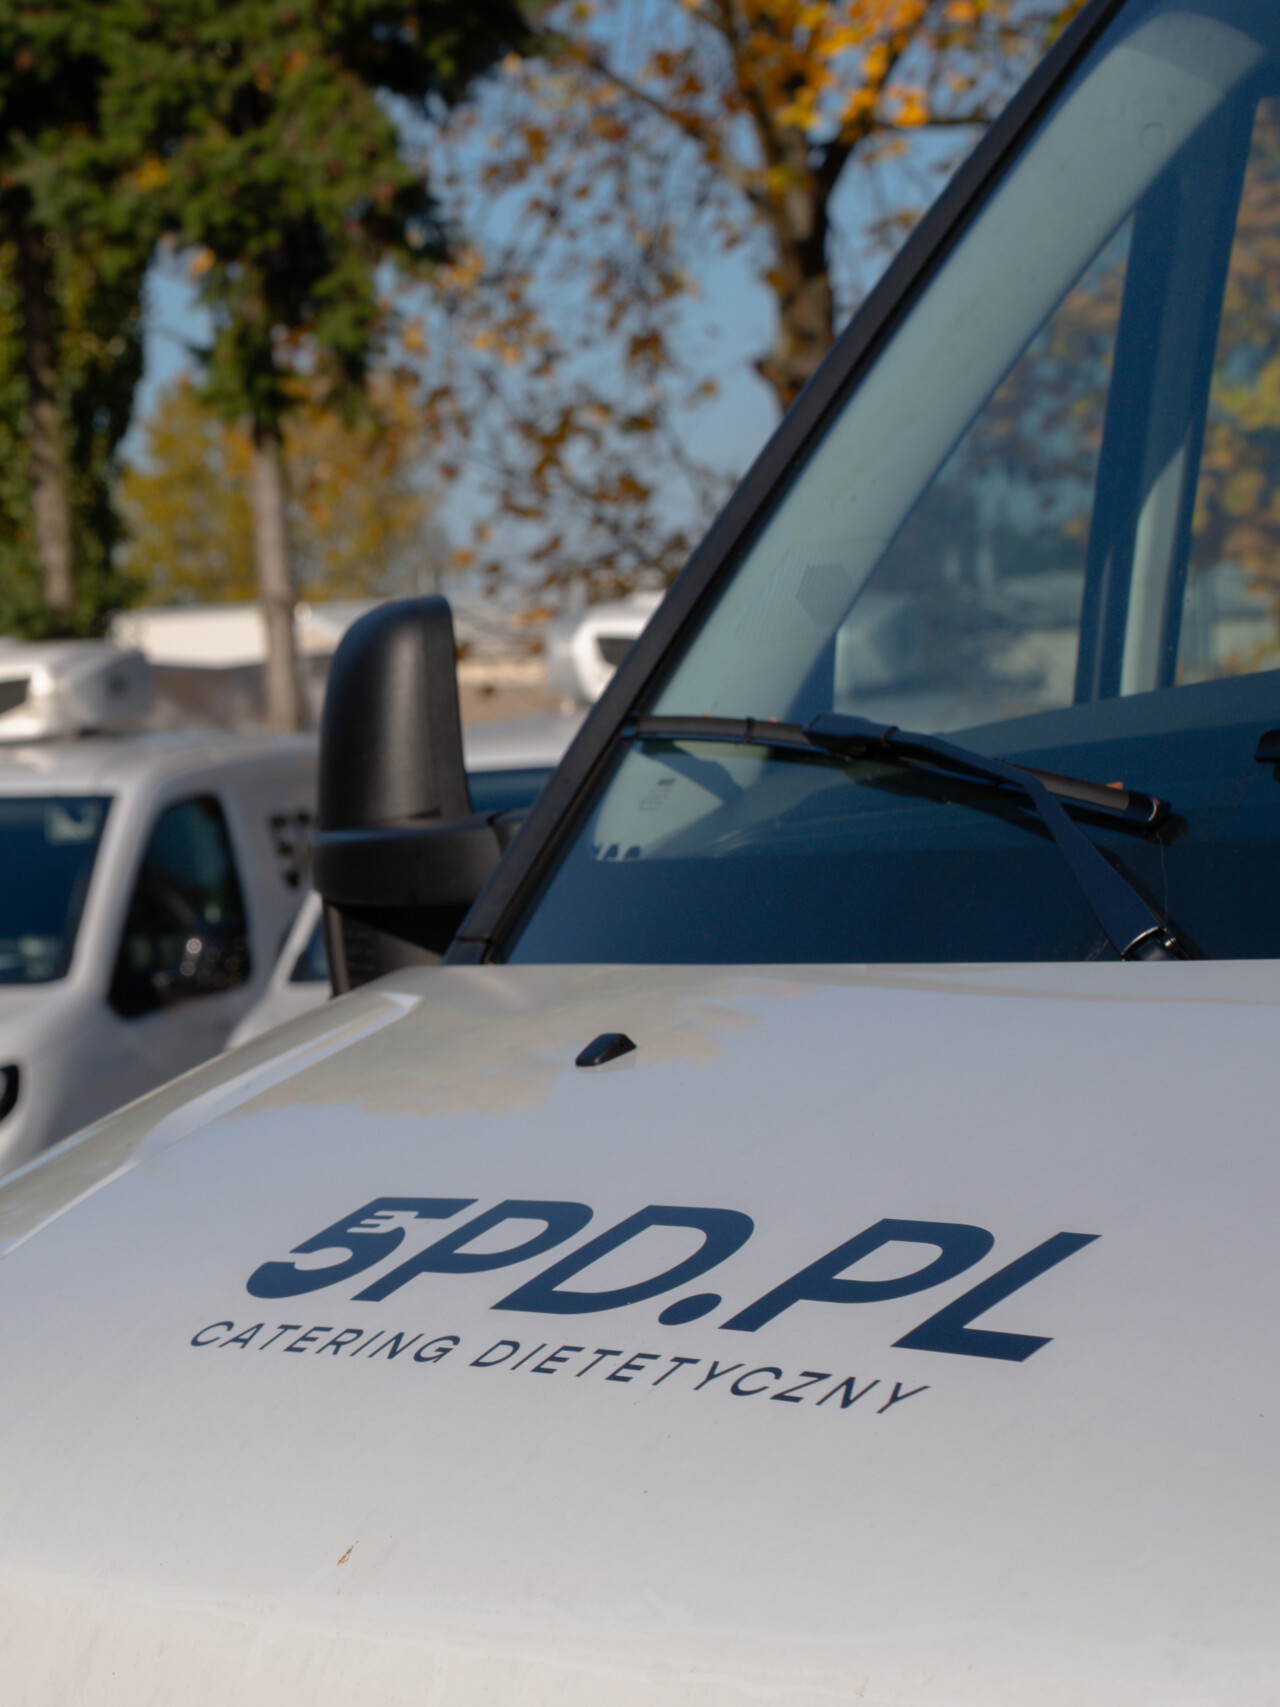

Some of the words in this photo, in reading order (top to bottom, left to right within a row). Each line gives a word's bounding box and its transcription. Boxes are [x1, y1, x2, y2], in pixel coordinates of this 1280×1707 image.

[244, 1196, 1104, 1363] 5PD.PL
[189, 1320, 462, 1364] CATERING
[468, 1339, 932, 1414] DIETETYCZNY
